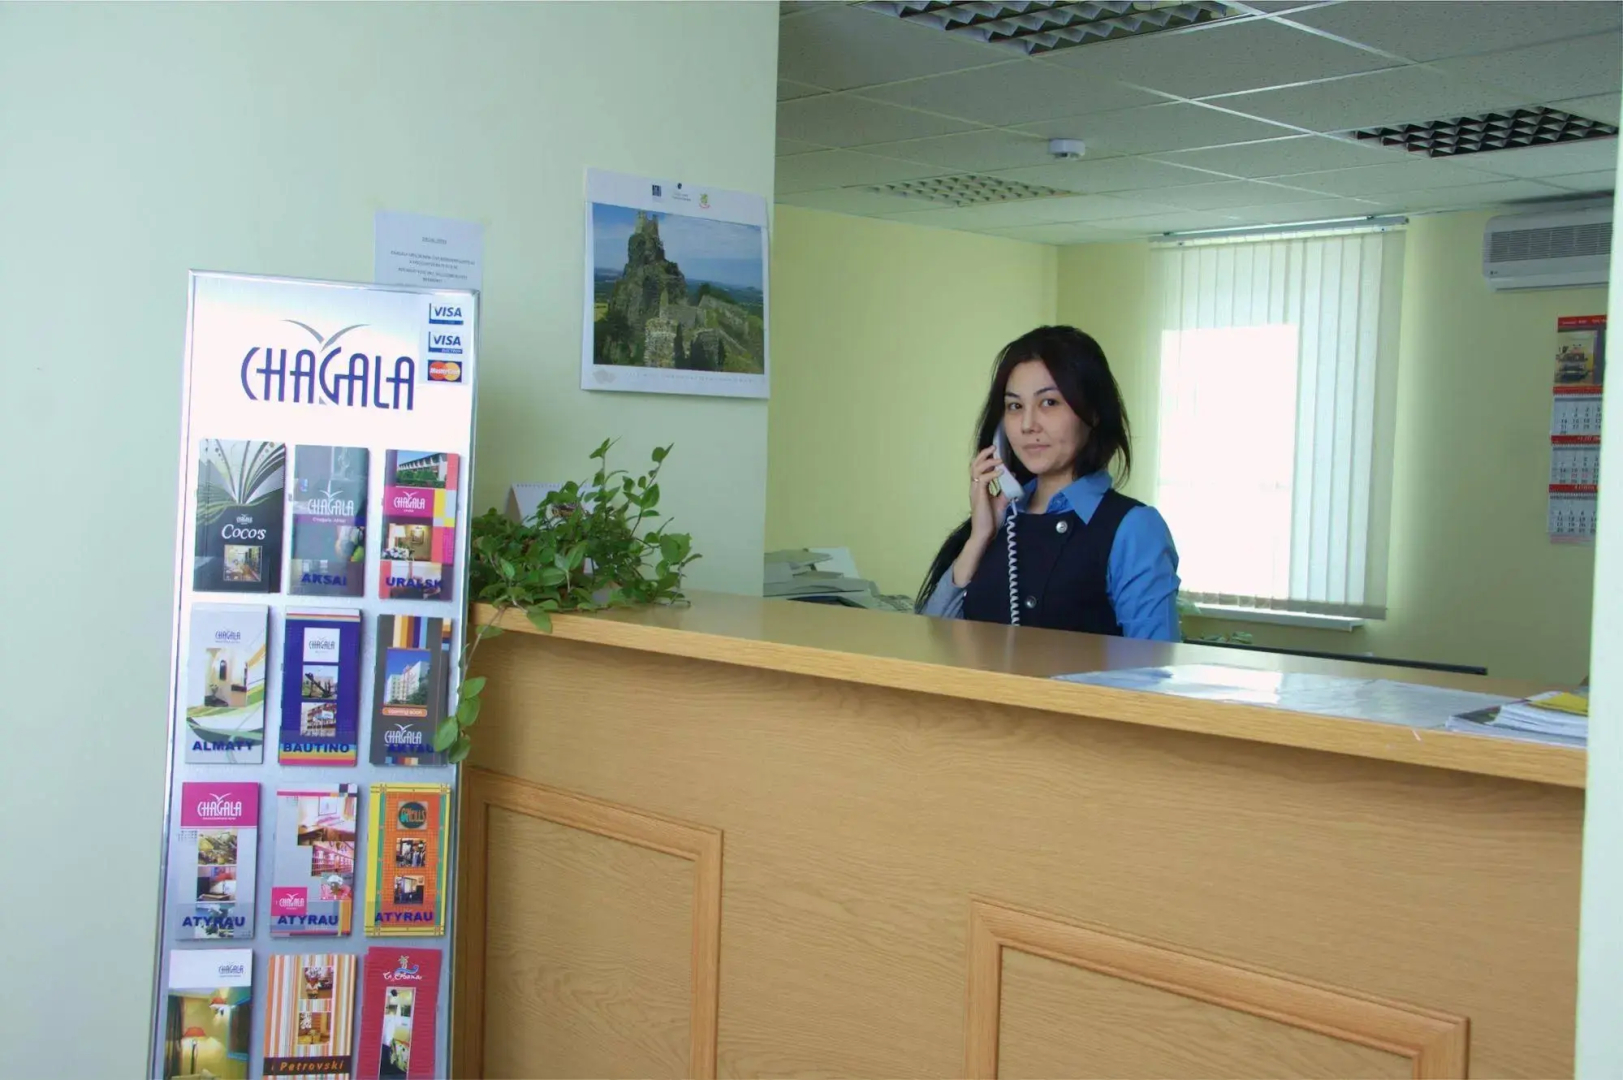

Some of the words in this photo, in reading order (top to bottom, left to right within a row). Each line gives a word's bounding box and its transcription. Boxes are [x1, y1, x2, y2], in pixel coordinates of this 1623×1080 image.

[433, 306, 463, 318] VISA
[433, 335, 462, 346] VISA
[241, 346, 415, 411] CHAGALA
[308, 499, 355, 516] CHAGALA
[393, 496, 426, 510] CHAGALA
[301, 574, 347, 586] AKSAI
[385, 576, 444, 589] URALSK
[215, 630, 241, 640] CHAGALA
[308, 640, 335, 650] CHAGALA
[384, 730, 423, 745] CHAGALA
[192, 741, 254, 751] ALMATY
[282, 742, 350, 753] BAUTINO
[197, 800, 242, 817] CHAGALA
[182, 916, 246, 927] ATYRAU
[277, 914, 339, 925] ATYRAU
[375, 911, 434, 923] ATYRAU
[218, 964, 244, 974] CHAGALA
[279, 1060, 344, 1072] Petrovski
